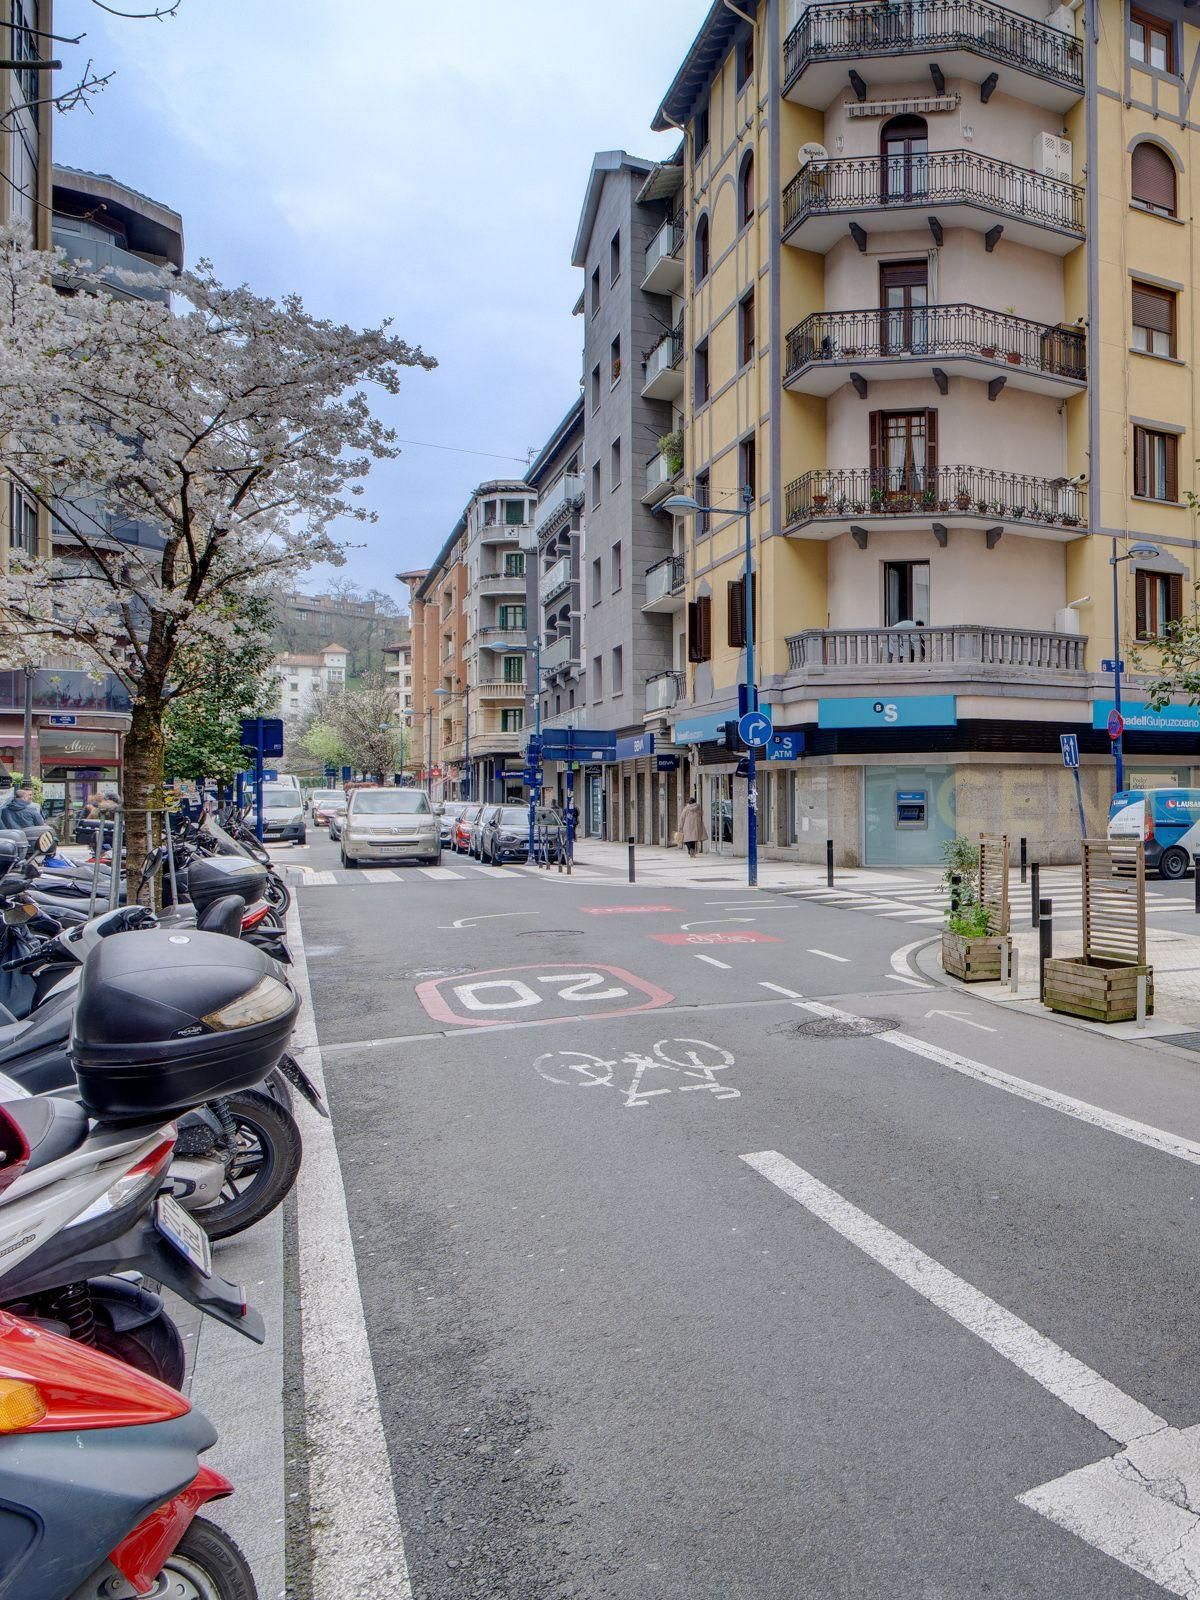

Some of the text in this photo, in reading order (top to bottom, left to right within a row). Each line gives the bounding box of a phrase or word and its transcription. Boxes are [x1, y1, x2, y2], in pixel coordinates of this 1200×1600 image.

[634, 738, 644, 752] BBVA
[774, 750, 792, 758] ATM
[453, 973, 628, 1010] 20
